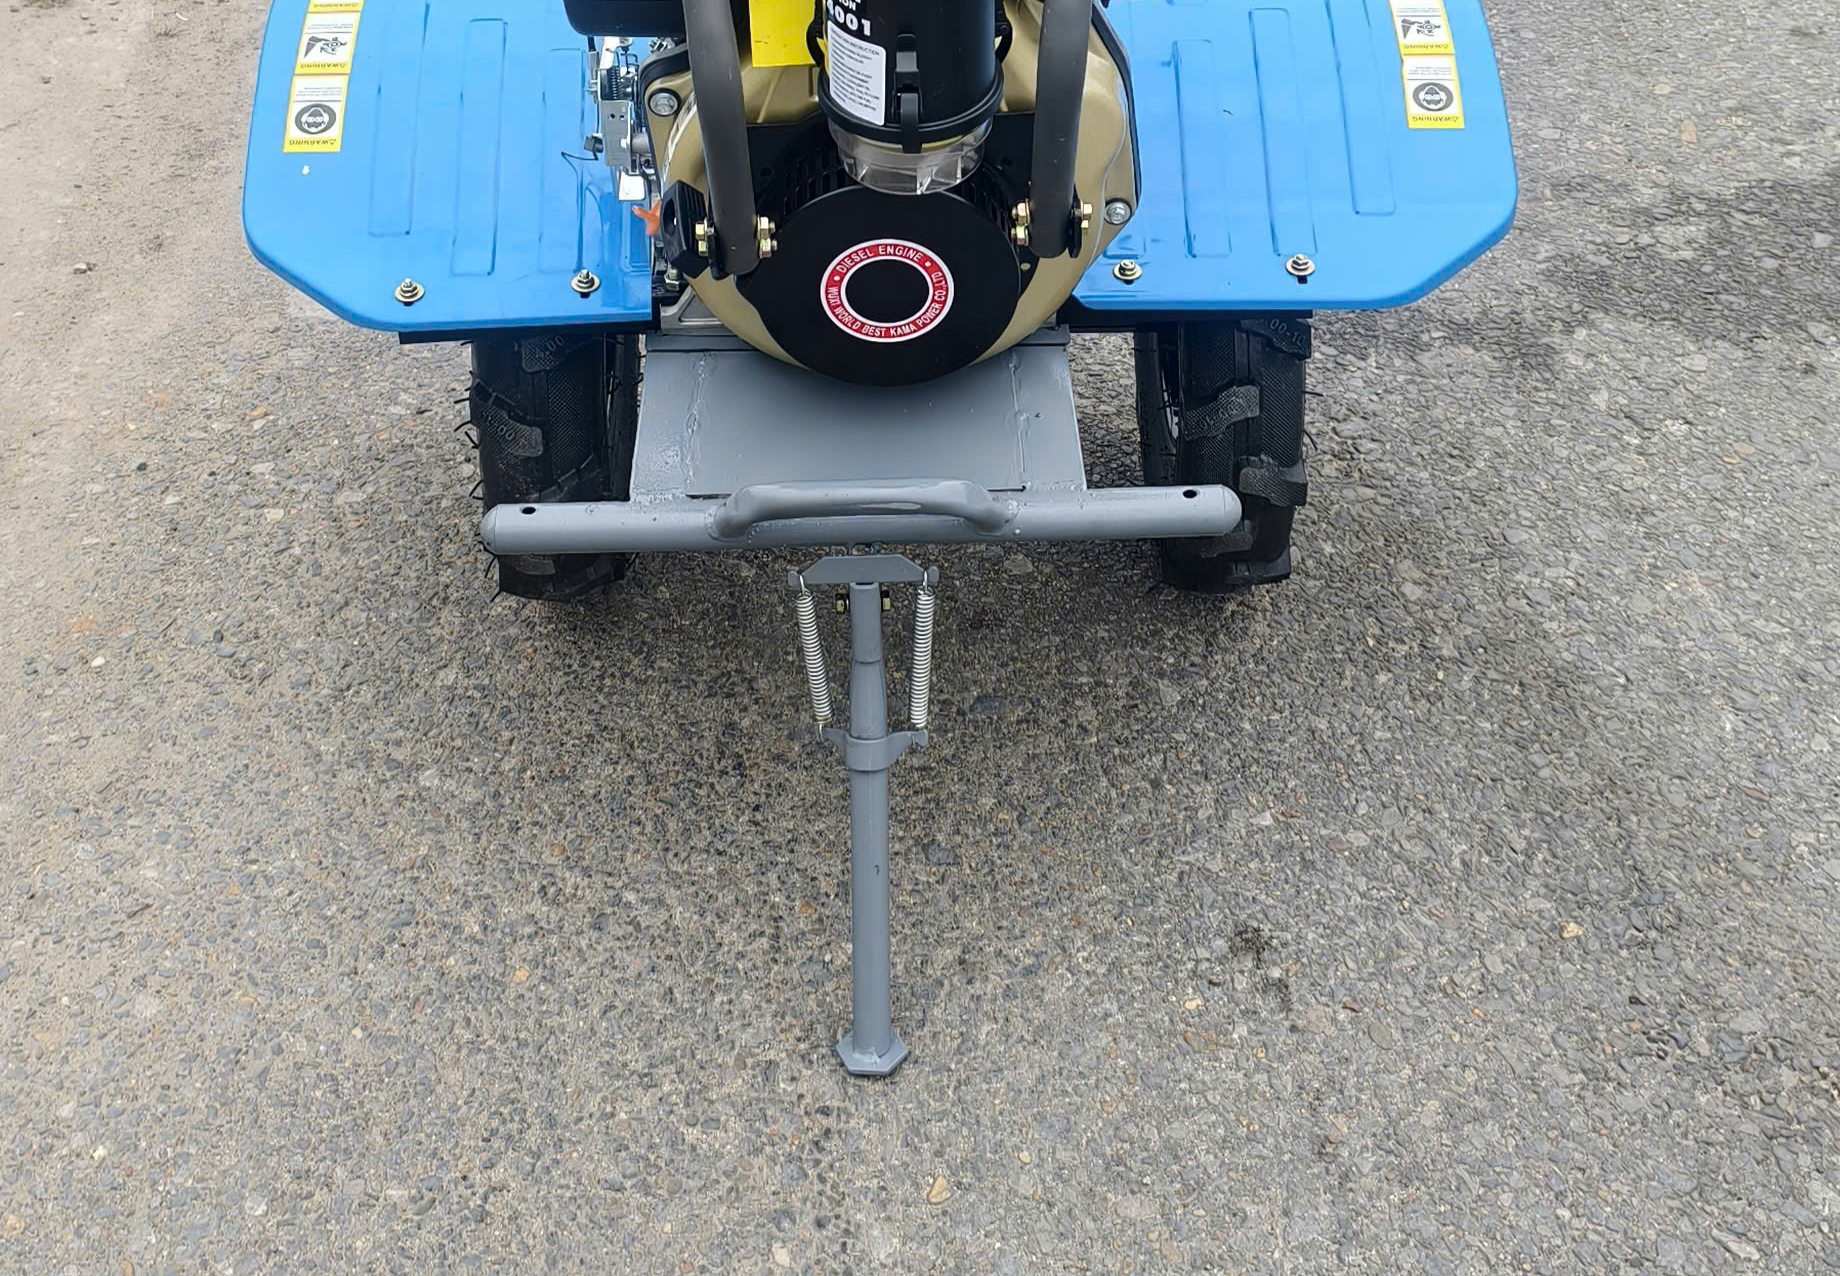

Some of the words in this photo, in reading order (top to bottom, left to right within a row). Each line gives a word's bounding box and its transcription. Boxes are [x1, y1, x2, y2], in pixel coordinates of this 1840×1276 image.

[836, 248, 874, 273] DIESEL
[878, 245, 923, 262] ENGINE
[827, 286, 839, 307] WUXI
[834, 305, 862, 329] WORLD
[861, 325, 887, 337] BEST
[890, 325, 918, 337] KAMA
[916, 303, 942, 328] POWER
